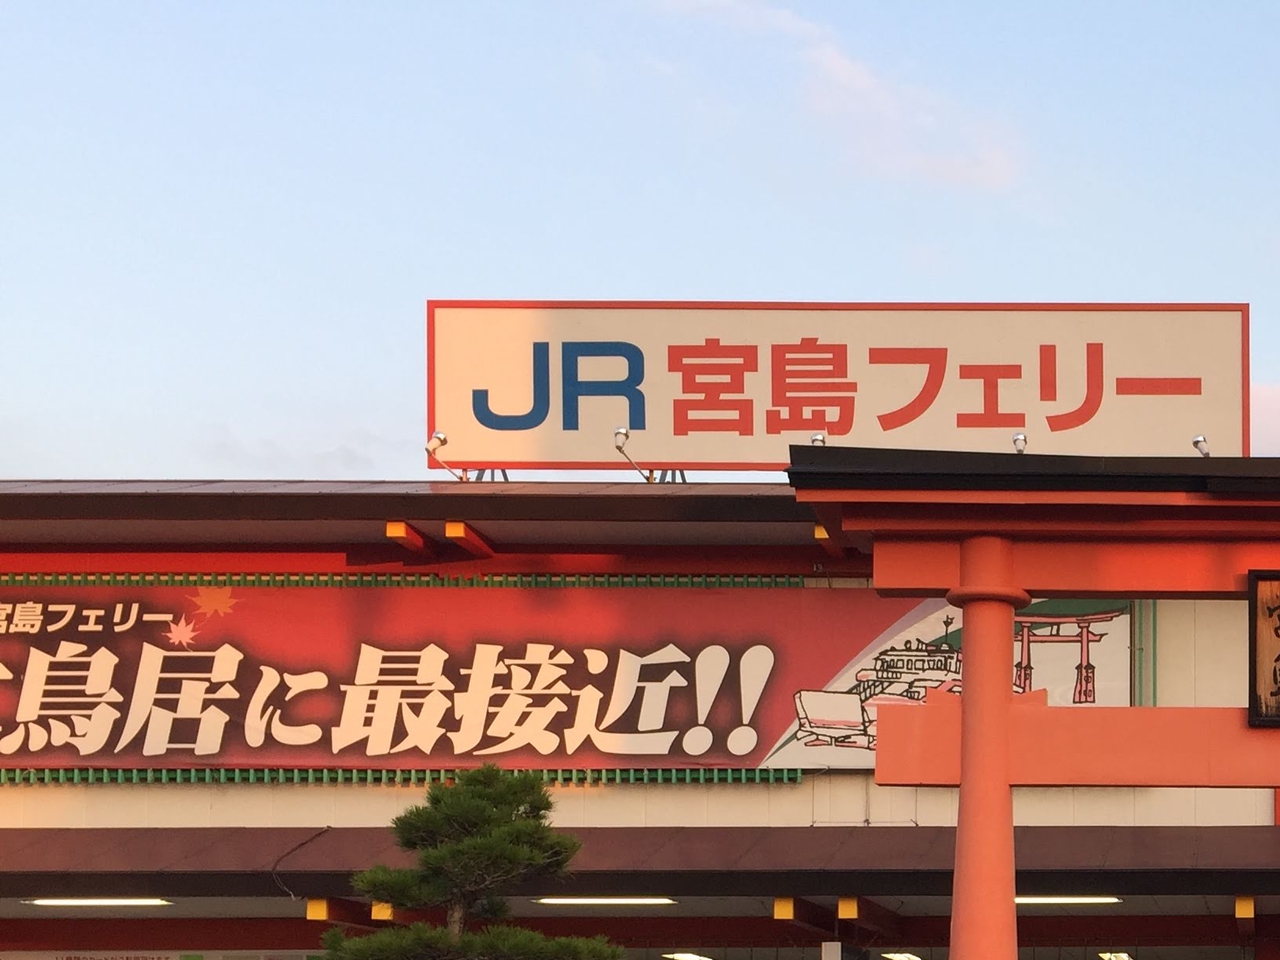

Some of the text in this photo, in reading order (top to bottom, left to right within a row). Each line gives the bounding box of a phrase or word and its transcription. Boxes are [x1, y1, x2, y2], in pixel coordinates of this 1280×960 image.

[471, 337, 1202, 437] JR宮島フェリー
[0, 641, 775, 757] 鳥居に最接近!!
